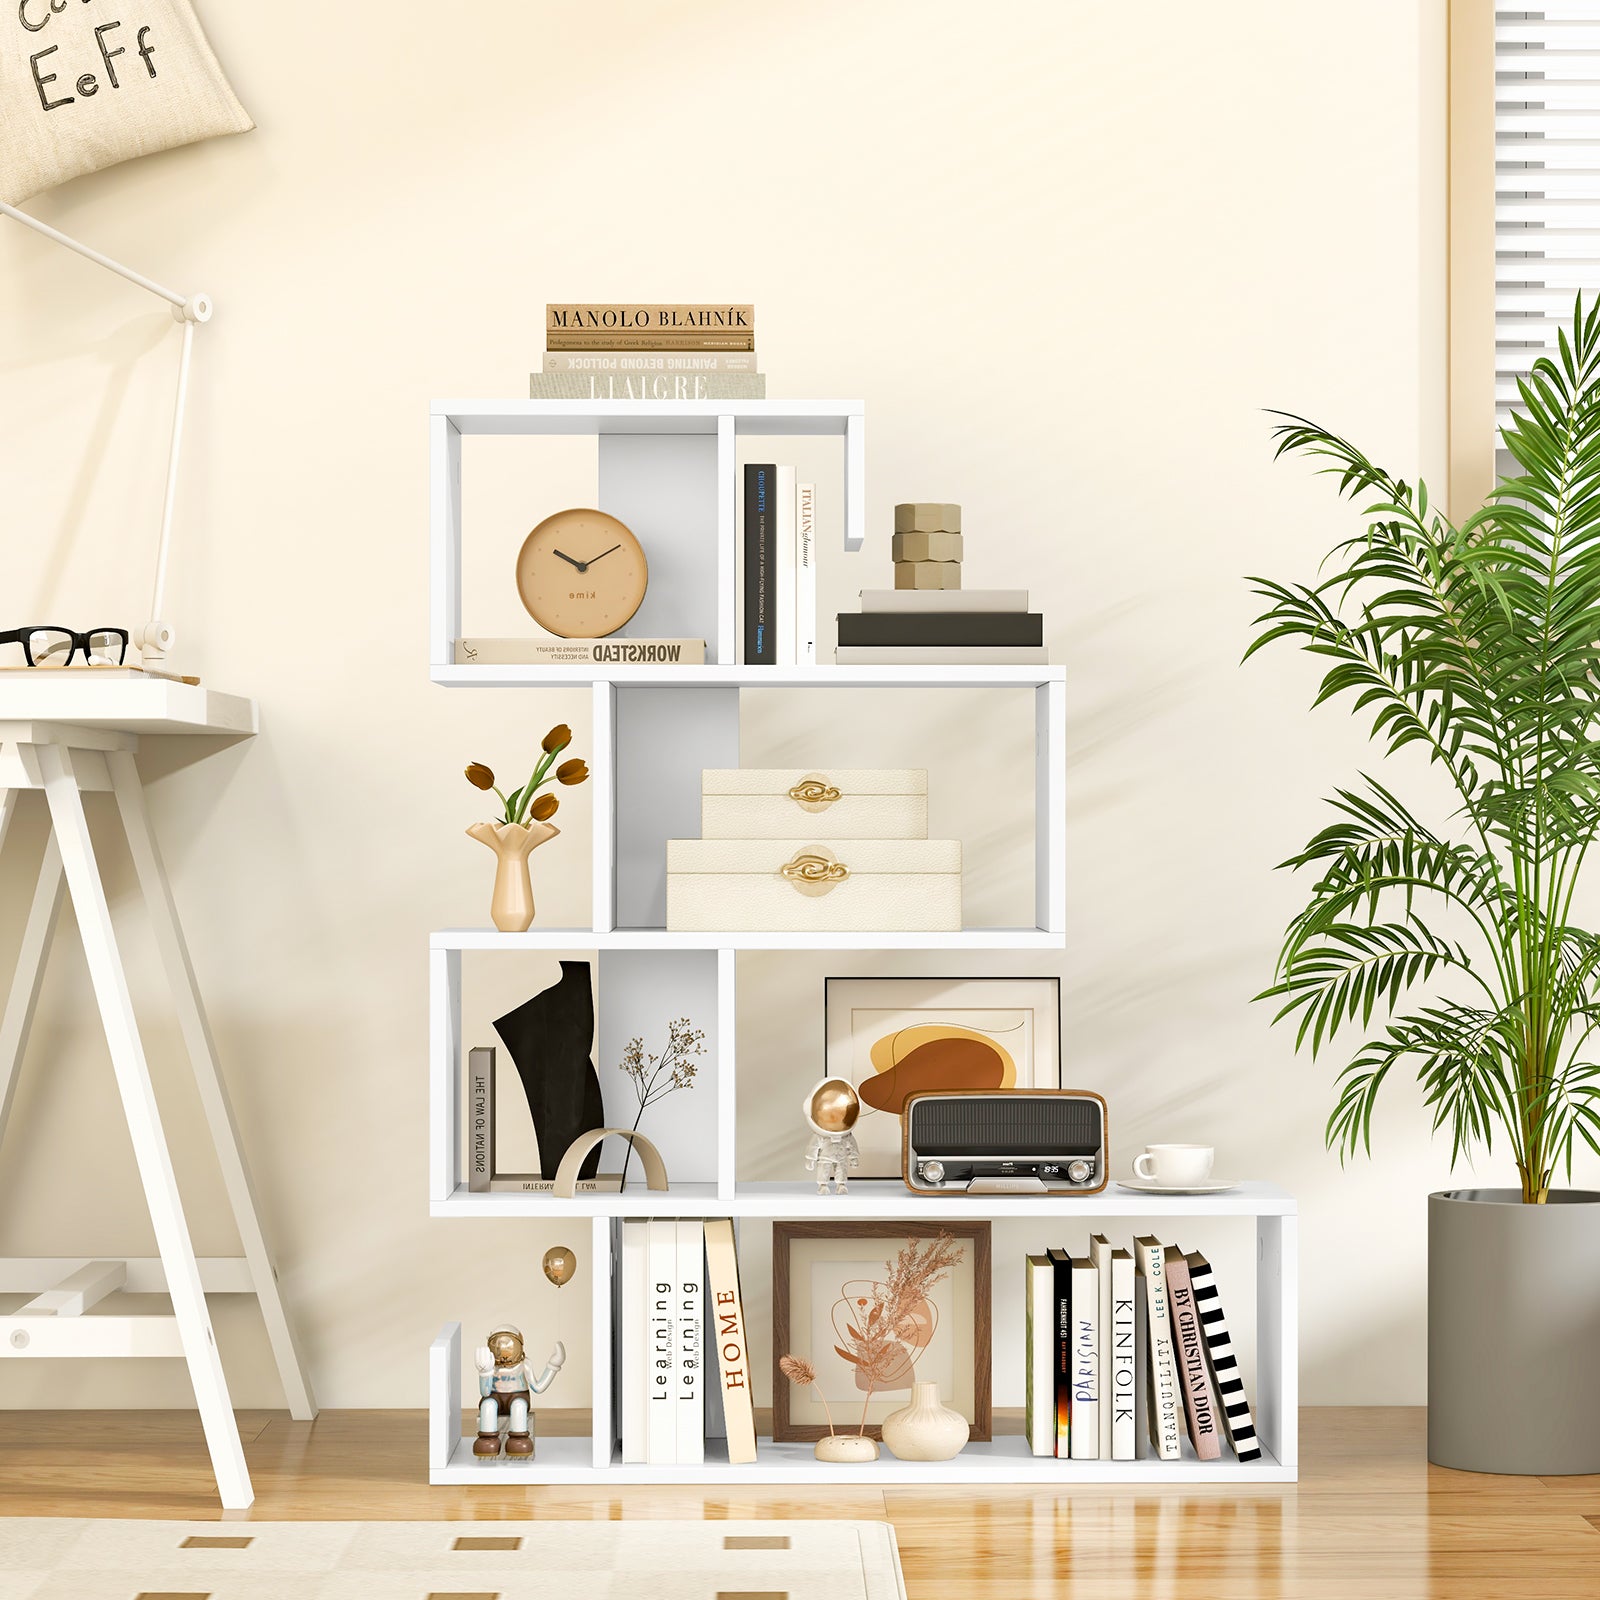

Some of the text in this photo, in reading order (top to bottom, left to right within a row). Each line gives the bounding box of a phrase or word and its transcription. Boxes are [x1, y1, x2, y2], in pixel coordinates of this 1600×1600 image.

[552, 307, 748, 327] MANOLO BLAHNÍK
[568, 358, 717, 369] PAINTING BEYOND POLLOCK
[590, 375, 708, 399] LIAIGRE
[757, 470, 765, 513] CHOUPETTE
[1151, 1248, 1165, 1319] LEE K. COLE
[652, 1282, 671, 1400] Learning
[679, 1282, 698, 1400] Learning
[716, 1289, 745, 1389] HOME
[1073, 1321, 1098, 1403] PARISIAN
[1115, 1300, 1133, 1423] KINFOLK
[1174, 1288, 1214, 1436] BY CHRISTIAN DIOR
[1157, 1338, 1178, 1452] TRANQUILITY
